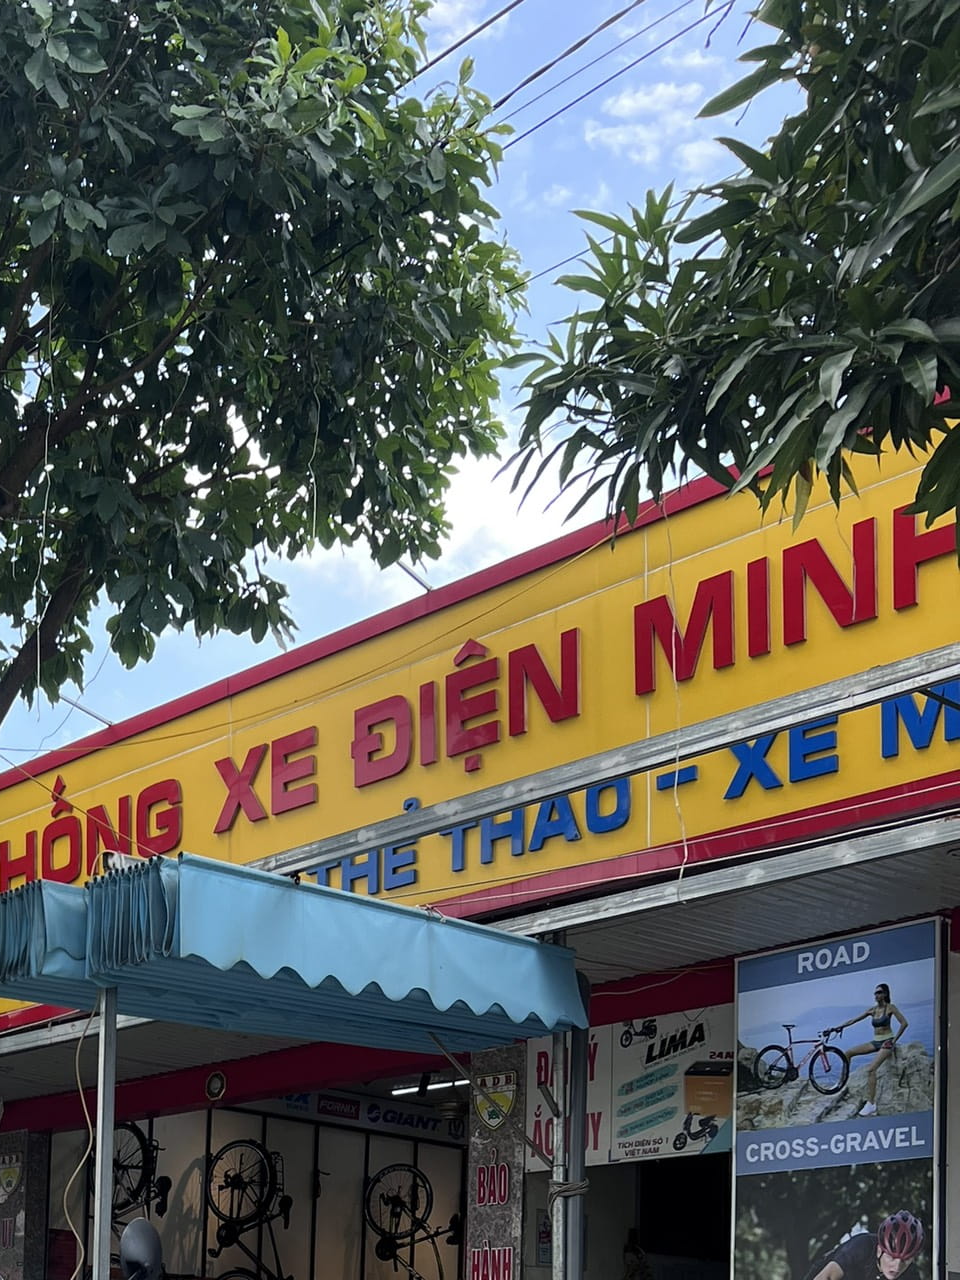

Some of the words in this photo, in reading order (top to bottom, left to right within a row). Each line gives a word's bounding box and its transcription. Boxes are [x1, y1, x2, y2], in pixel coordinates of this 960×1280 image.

[214, 726, 319, 833] XE
[350, 627, 580, 788] ĐIỆN
[723, 714, 839, 800] XE
[797, 941, 871, 975] ROAD
[645, 1022, 706, 1065] LIMA
[319, 1099, 359, 1115] FORNIX
[382, 1109, 443, 1132] GIANT
[745, 1126, 925, 1163] CROSS-GRAVEL
[476, 1148, 509, 1206] BẢO
